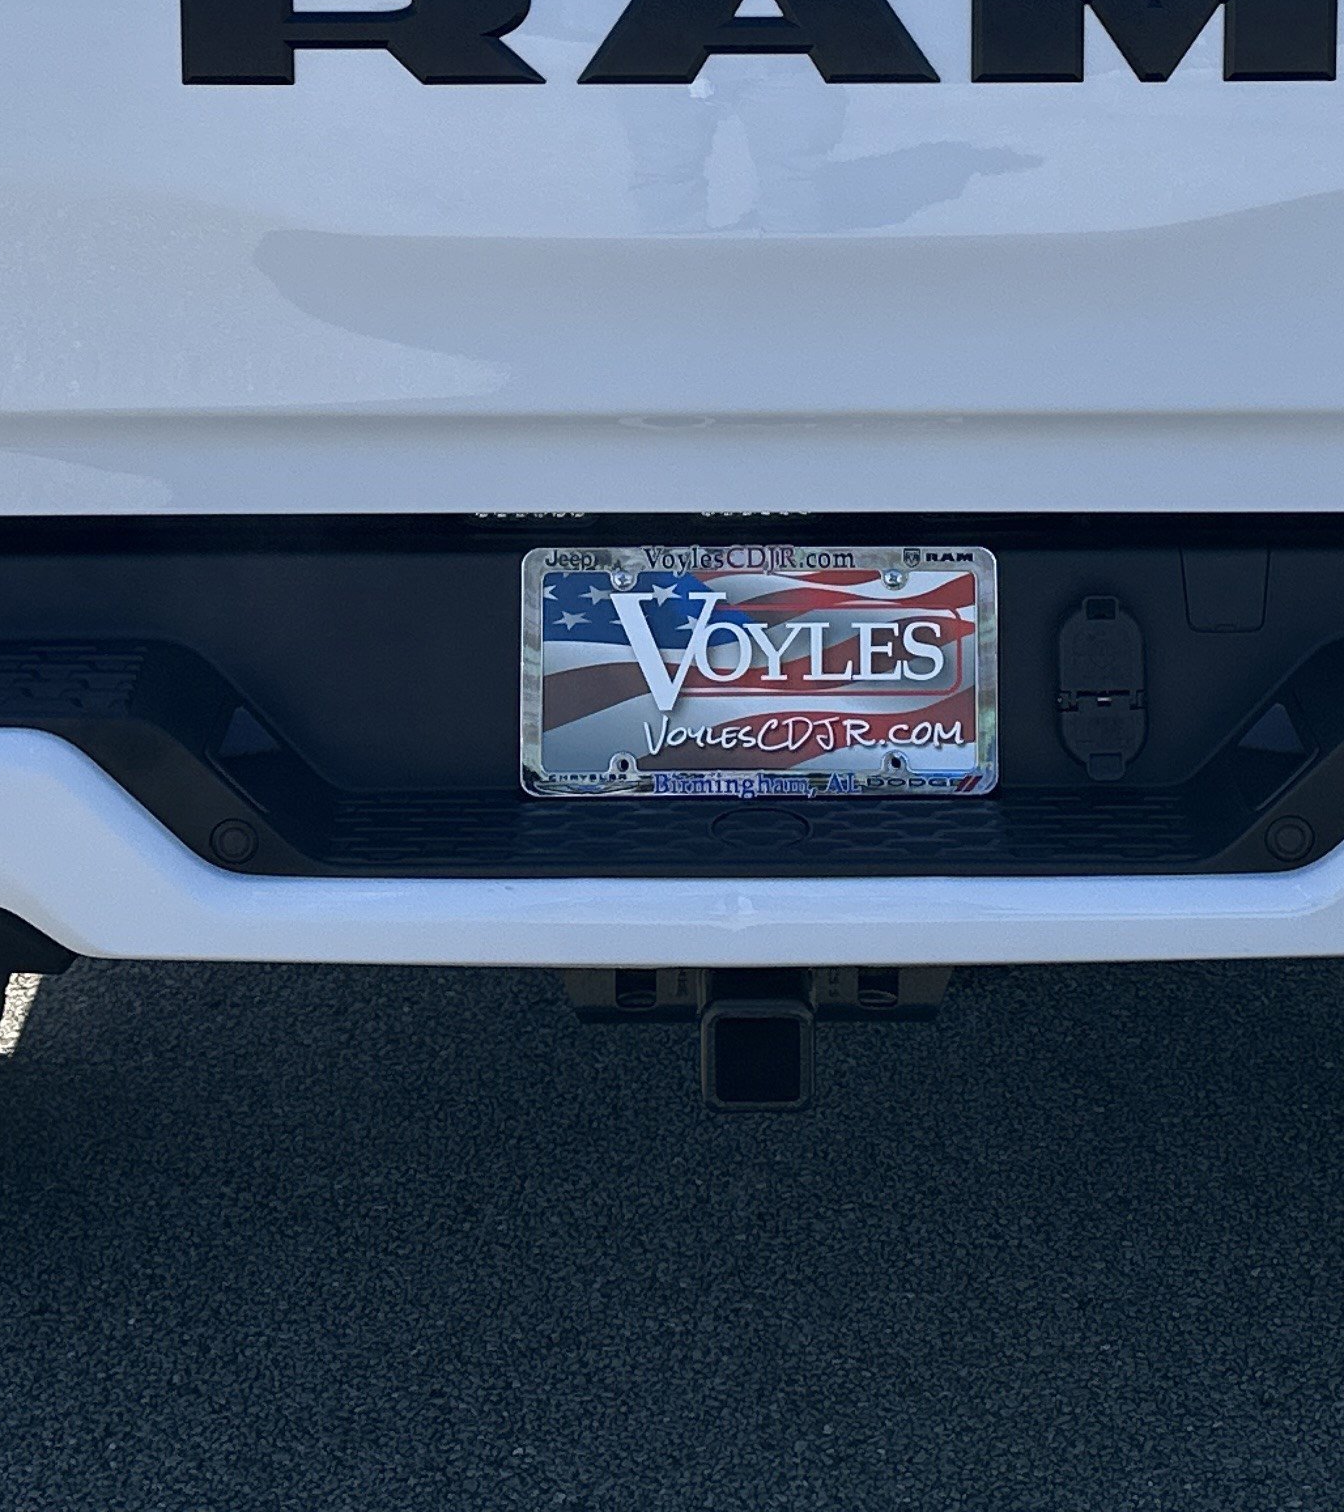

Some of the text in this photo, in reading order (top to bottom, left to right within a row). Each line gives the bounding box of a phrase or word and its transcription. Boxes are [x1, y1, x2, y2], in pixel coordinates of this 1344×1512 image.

[545, 549, 595, 569] Jeep
[646, 546, 856, 574] VoylesCDJR.com
[925, 552, 973, 562] RAM
[652, 771, 817, 799] Birmingham,
